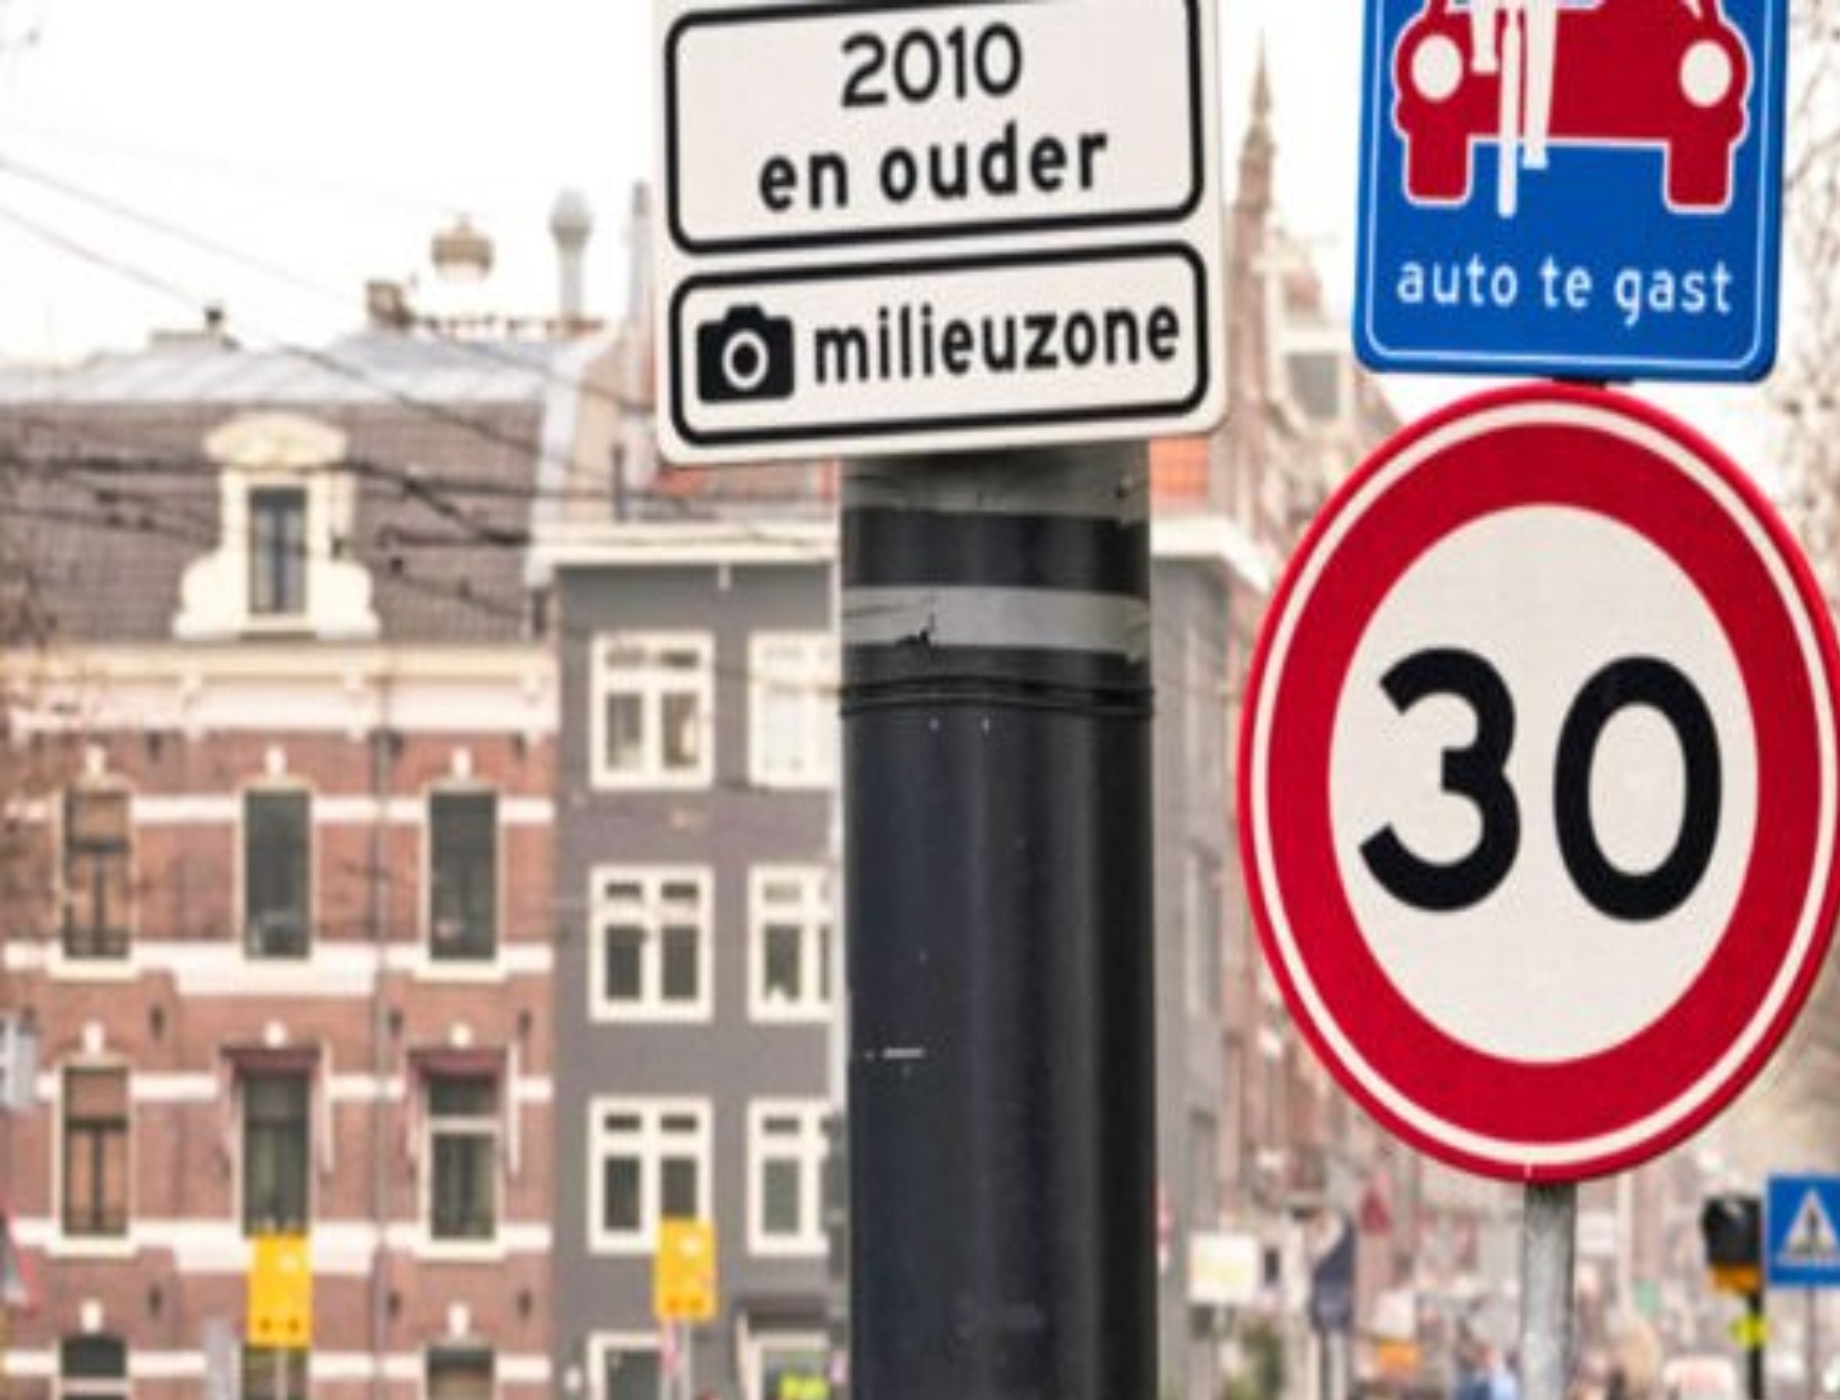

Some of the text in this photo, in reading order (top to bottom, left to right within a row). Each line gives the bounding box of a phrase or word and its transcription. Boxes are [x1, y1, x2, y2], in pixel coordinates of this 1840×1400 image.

[841, 21, 1023, 108] 2010
[759, 120, 1108, 213] en ouder
[1396, 253, 1733, 328] auto te gast
[813, 302, 1181, 385] milieuzone
[1358, 646, 1723, 925] 30
